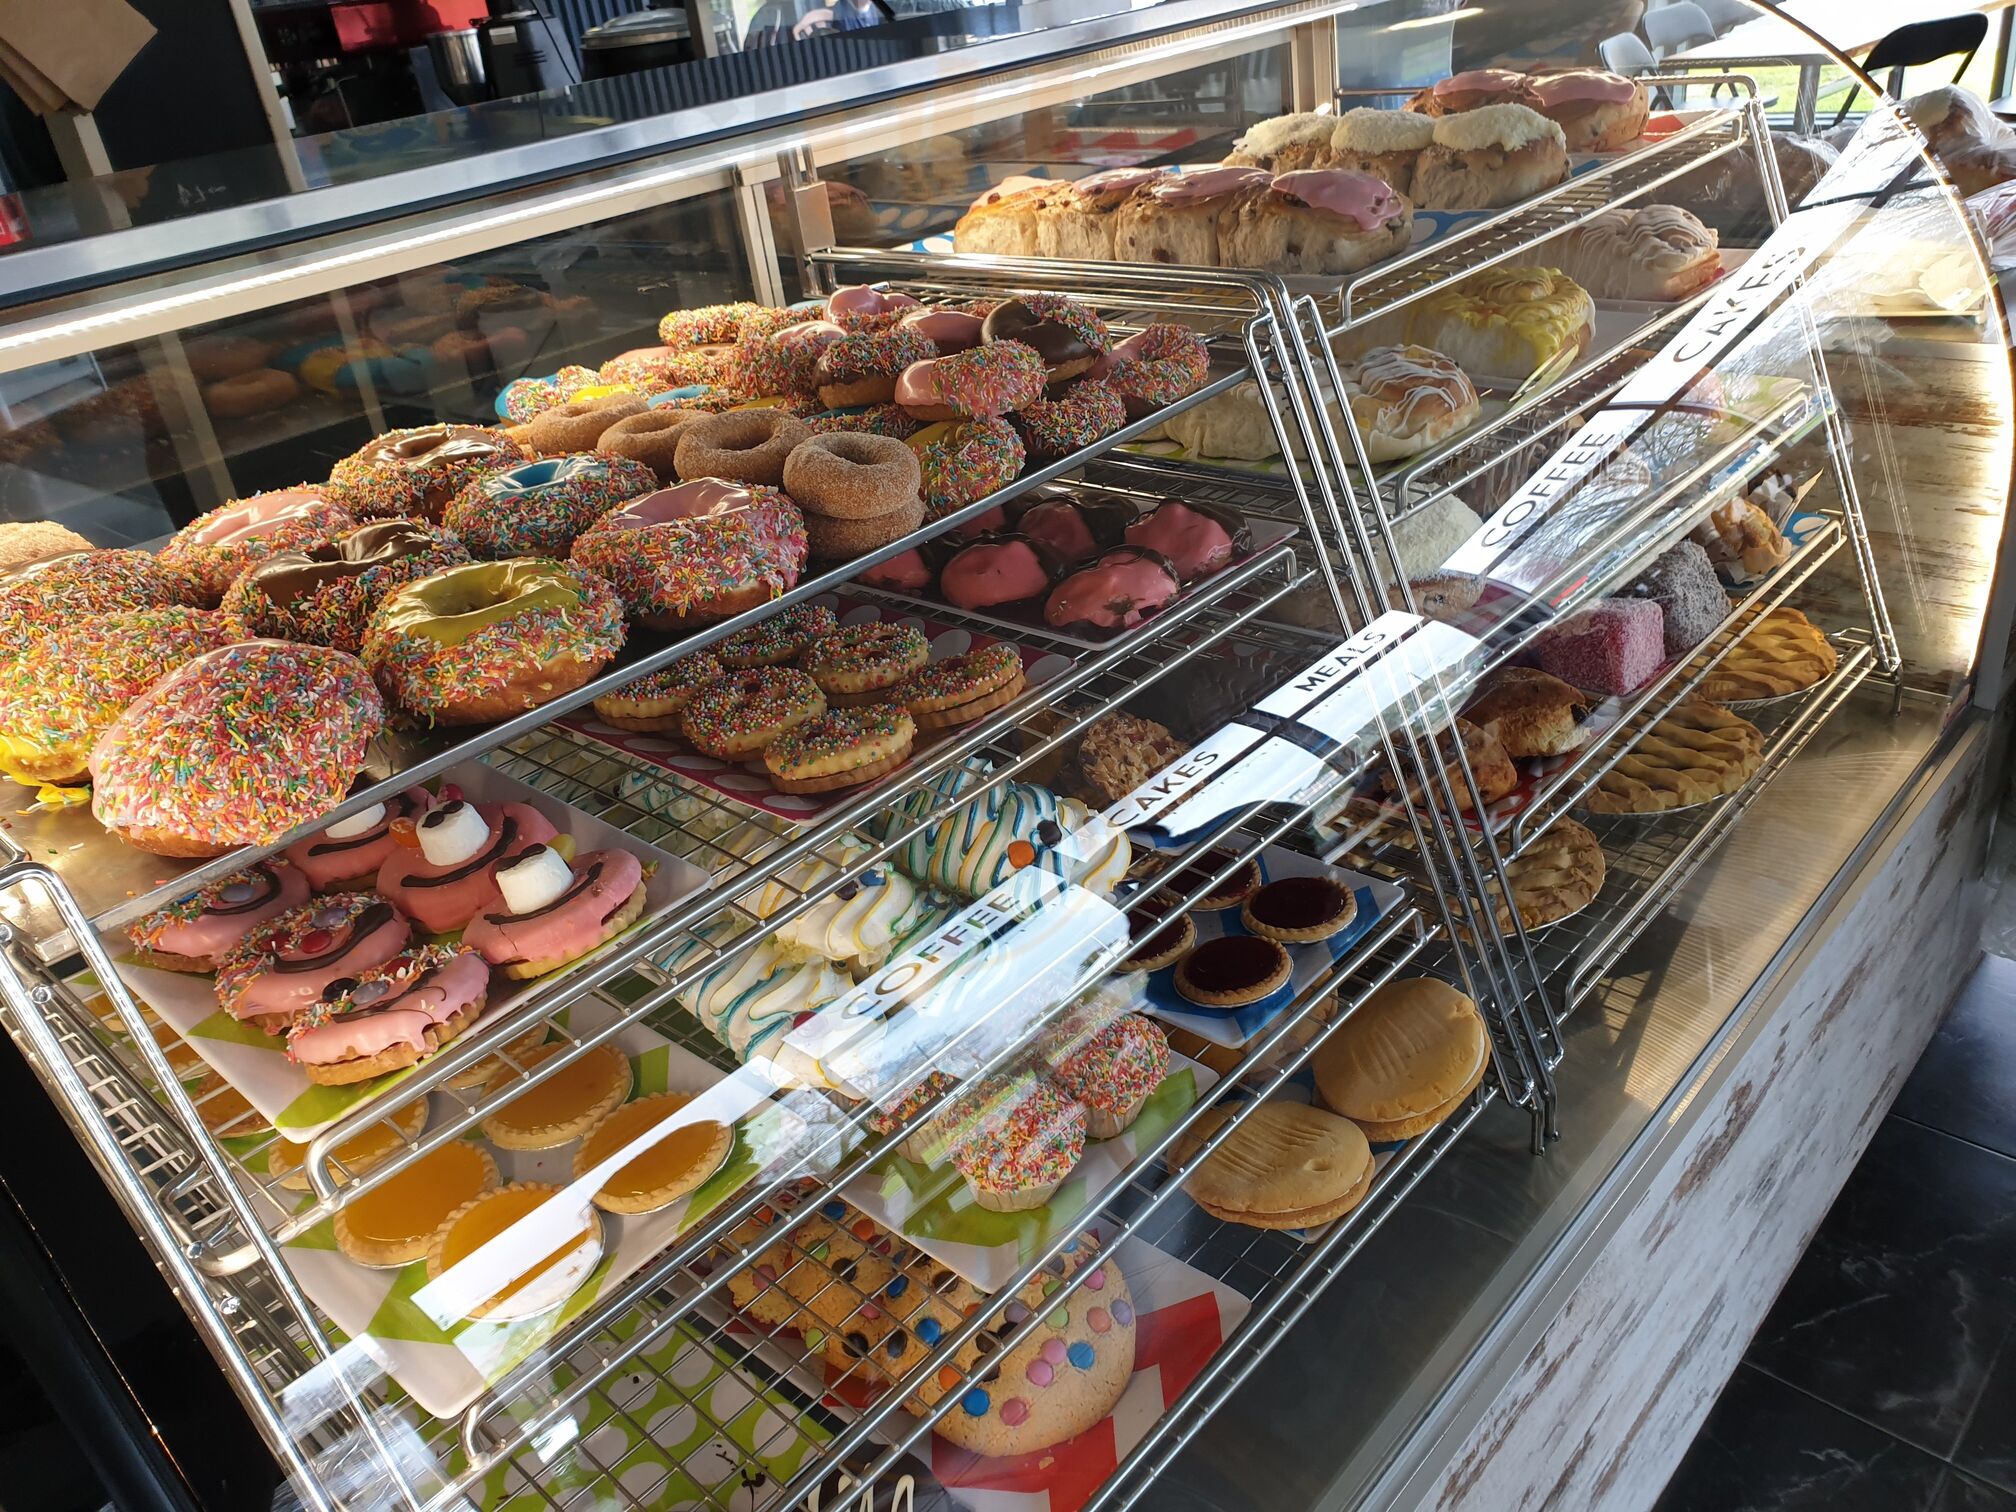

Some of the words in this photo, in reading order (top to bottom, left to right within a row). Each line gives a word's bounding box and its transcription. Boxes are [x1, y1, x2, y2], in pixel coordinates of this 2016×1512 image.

[1482, 433, 1615, 546] COFFEE
[1674, 247, 1806, 362] CAKES
[842, 893, 1020, 1018] COFFEE
[1107, 751, 1218, 827] CAKES
[1294, 631, 1385, 692] MEALS
